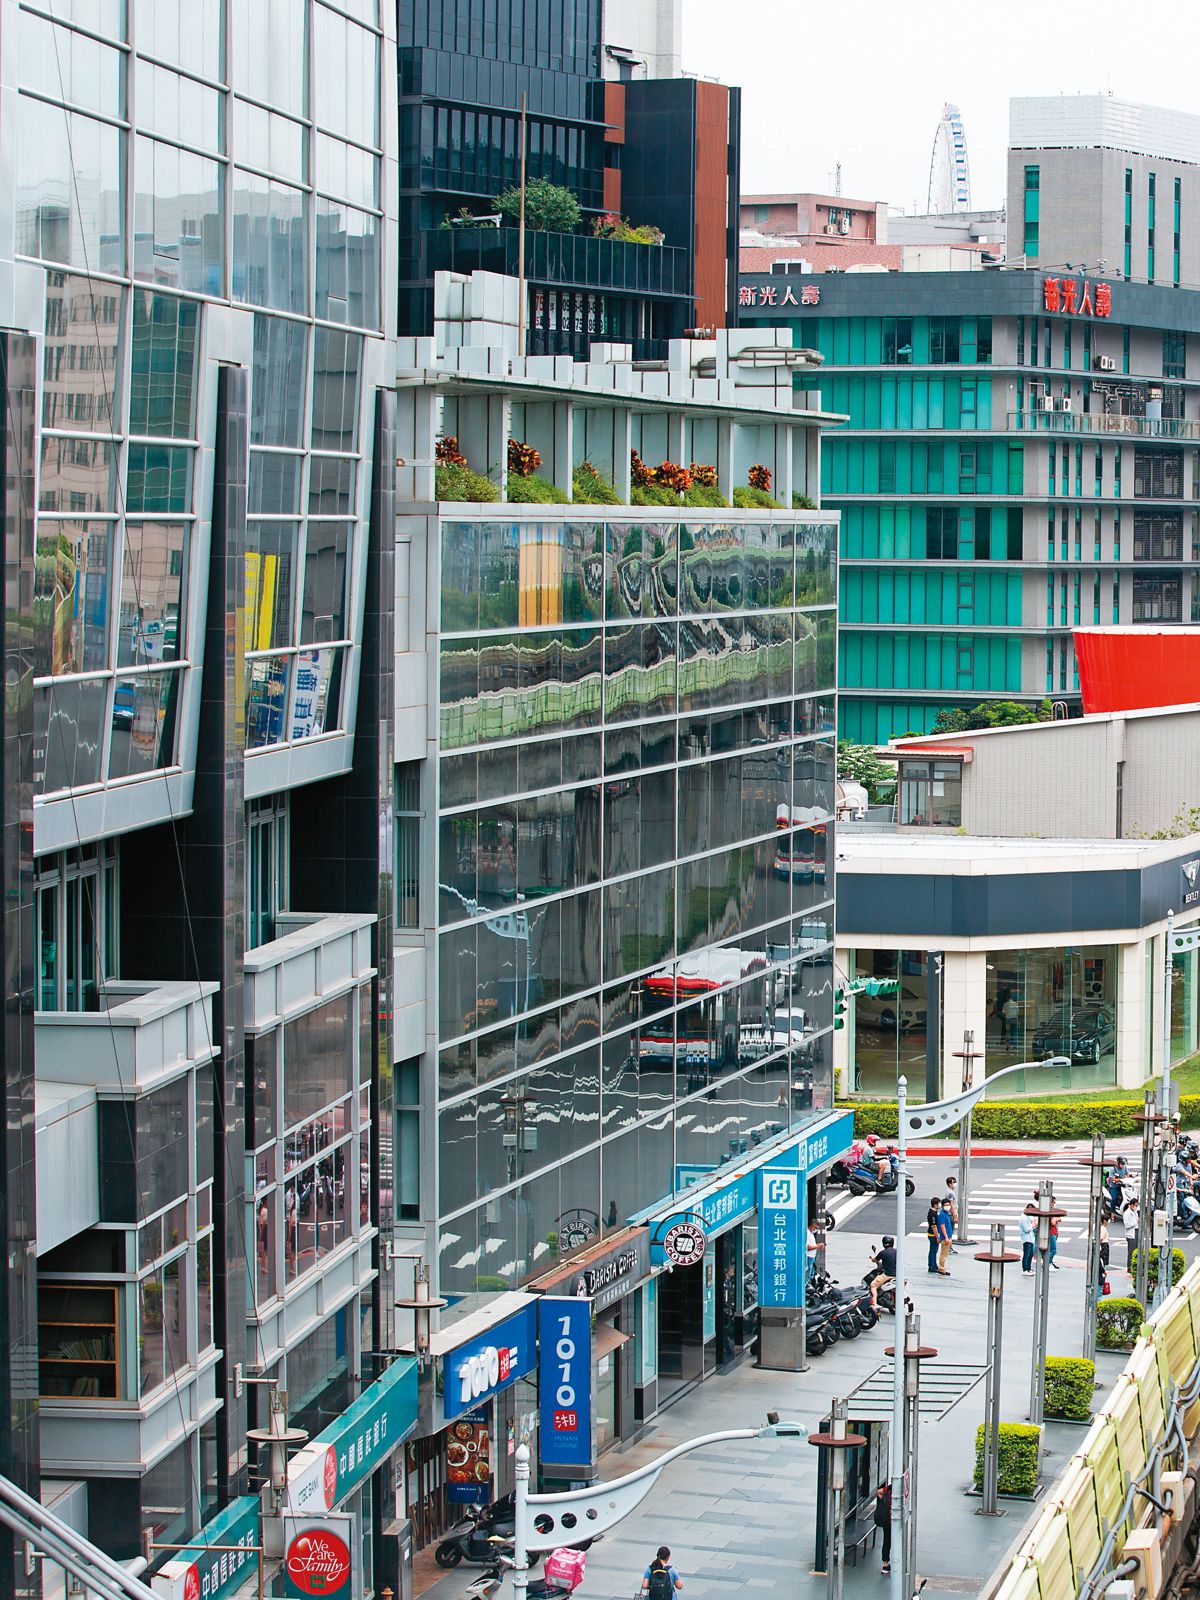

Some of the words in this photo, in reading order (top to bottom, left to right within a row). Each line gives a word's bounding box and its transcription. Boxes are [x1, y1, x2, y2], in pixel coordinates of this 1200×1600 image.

[738, 284, 820, 306] 新光人壽
[1044, 276, 1112, 318] 新光人壽
[1184, 889, 1200, 904] BENTLEY
[666, 1225, 702, 1244] BARISTA
[667, 1246, 702, 1264] COFFEE
[774, 1212, 787, 1302] 台北富邦銀行
[590, 1262, 617, 1294] BARISTA
[618, 1248, 638, 1276] COFFEE
[459, 1345, 499, 1403] 1010
[556, 1315, 576, 1407] 1010
[555, 1413, 576, 1428] 湘
[339, 1411, 388, 1479] 中國信託銀行
[307, 1538, 329, 1552] We
[317, 1551, 336, 1561] are
[202, 1528, 254, 1600] 中國信託銀行
[288, 1551, 350, 1582] Family
